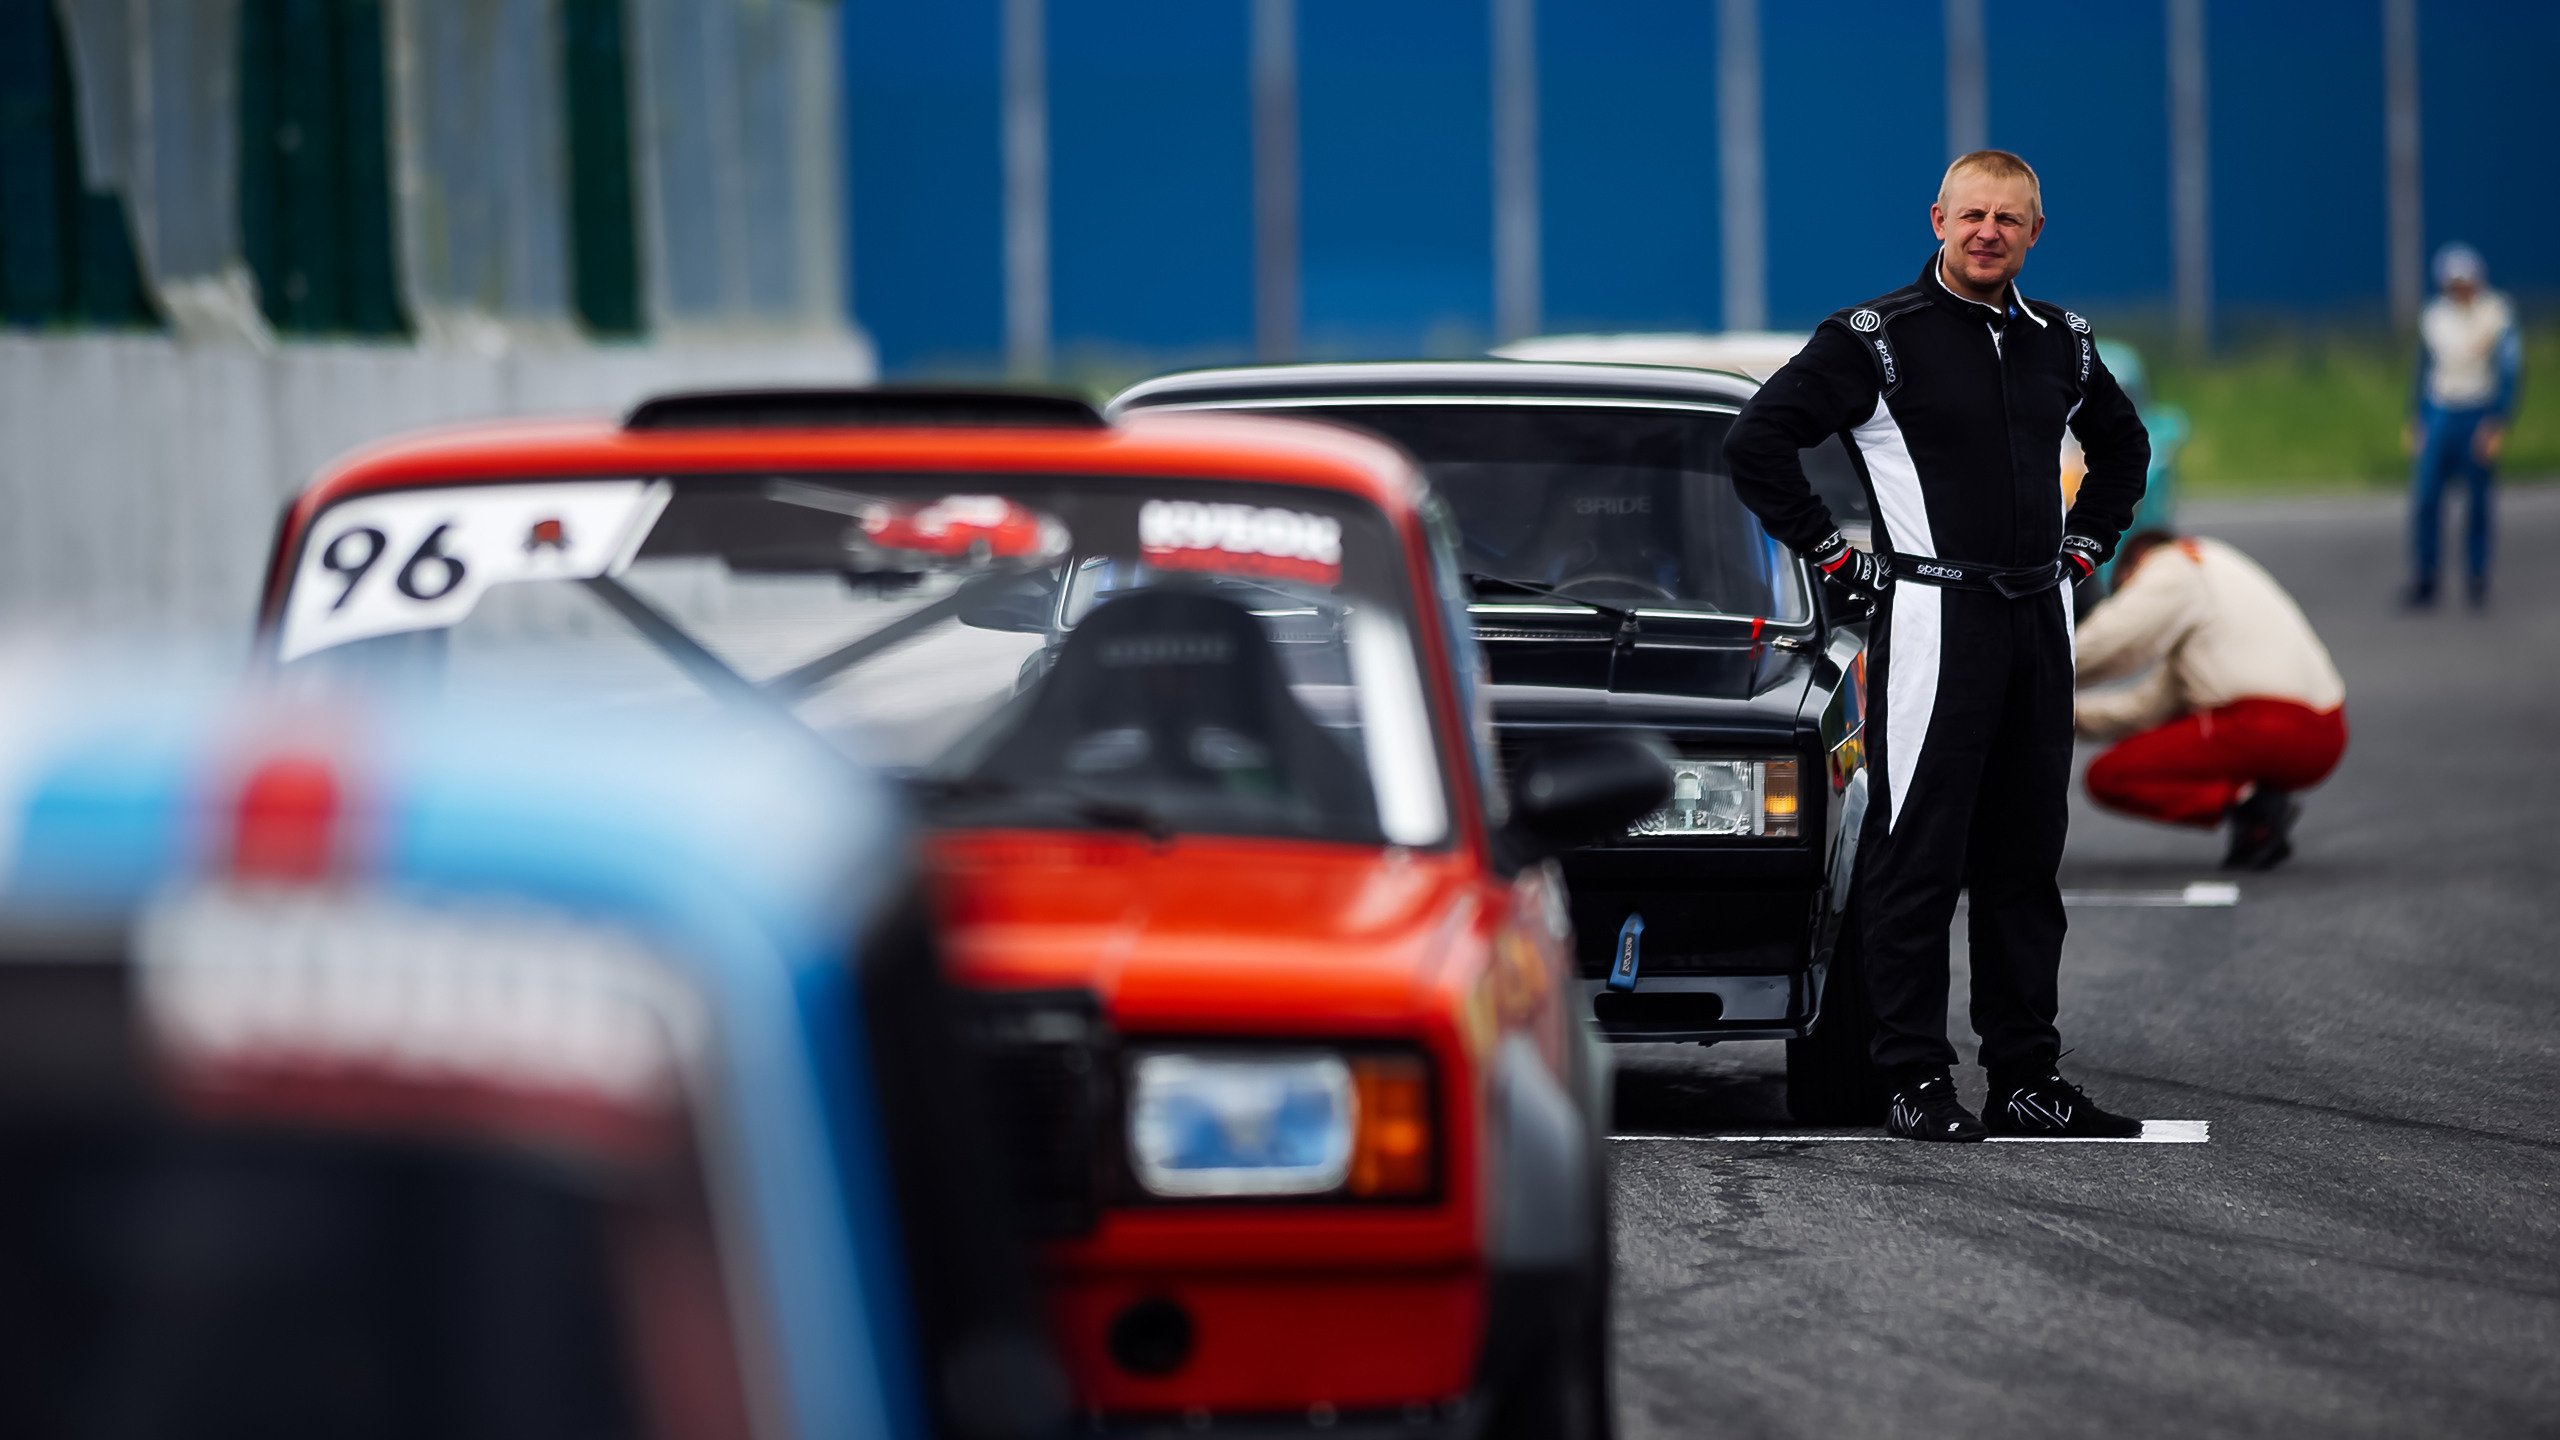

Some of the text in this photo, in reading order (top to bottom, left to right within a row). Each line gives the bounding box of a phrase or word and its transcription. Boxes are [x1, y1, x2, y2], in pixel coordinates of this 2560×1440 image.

[1874, 340, 1896, 384] sparco
[2081, 338, 2091, 382] sparco
[1575, 496, 1651, 514] BRIDE
[2064, 536, 2102, 553] sparc
[323, 524, 465, 611] 96
[1916, 564, 1962, 580] sparco
